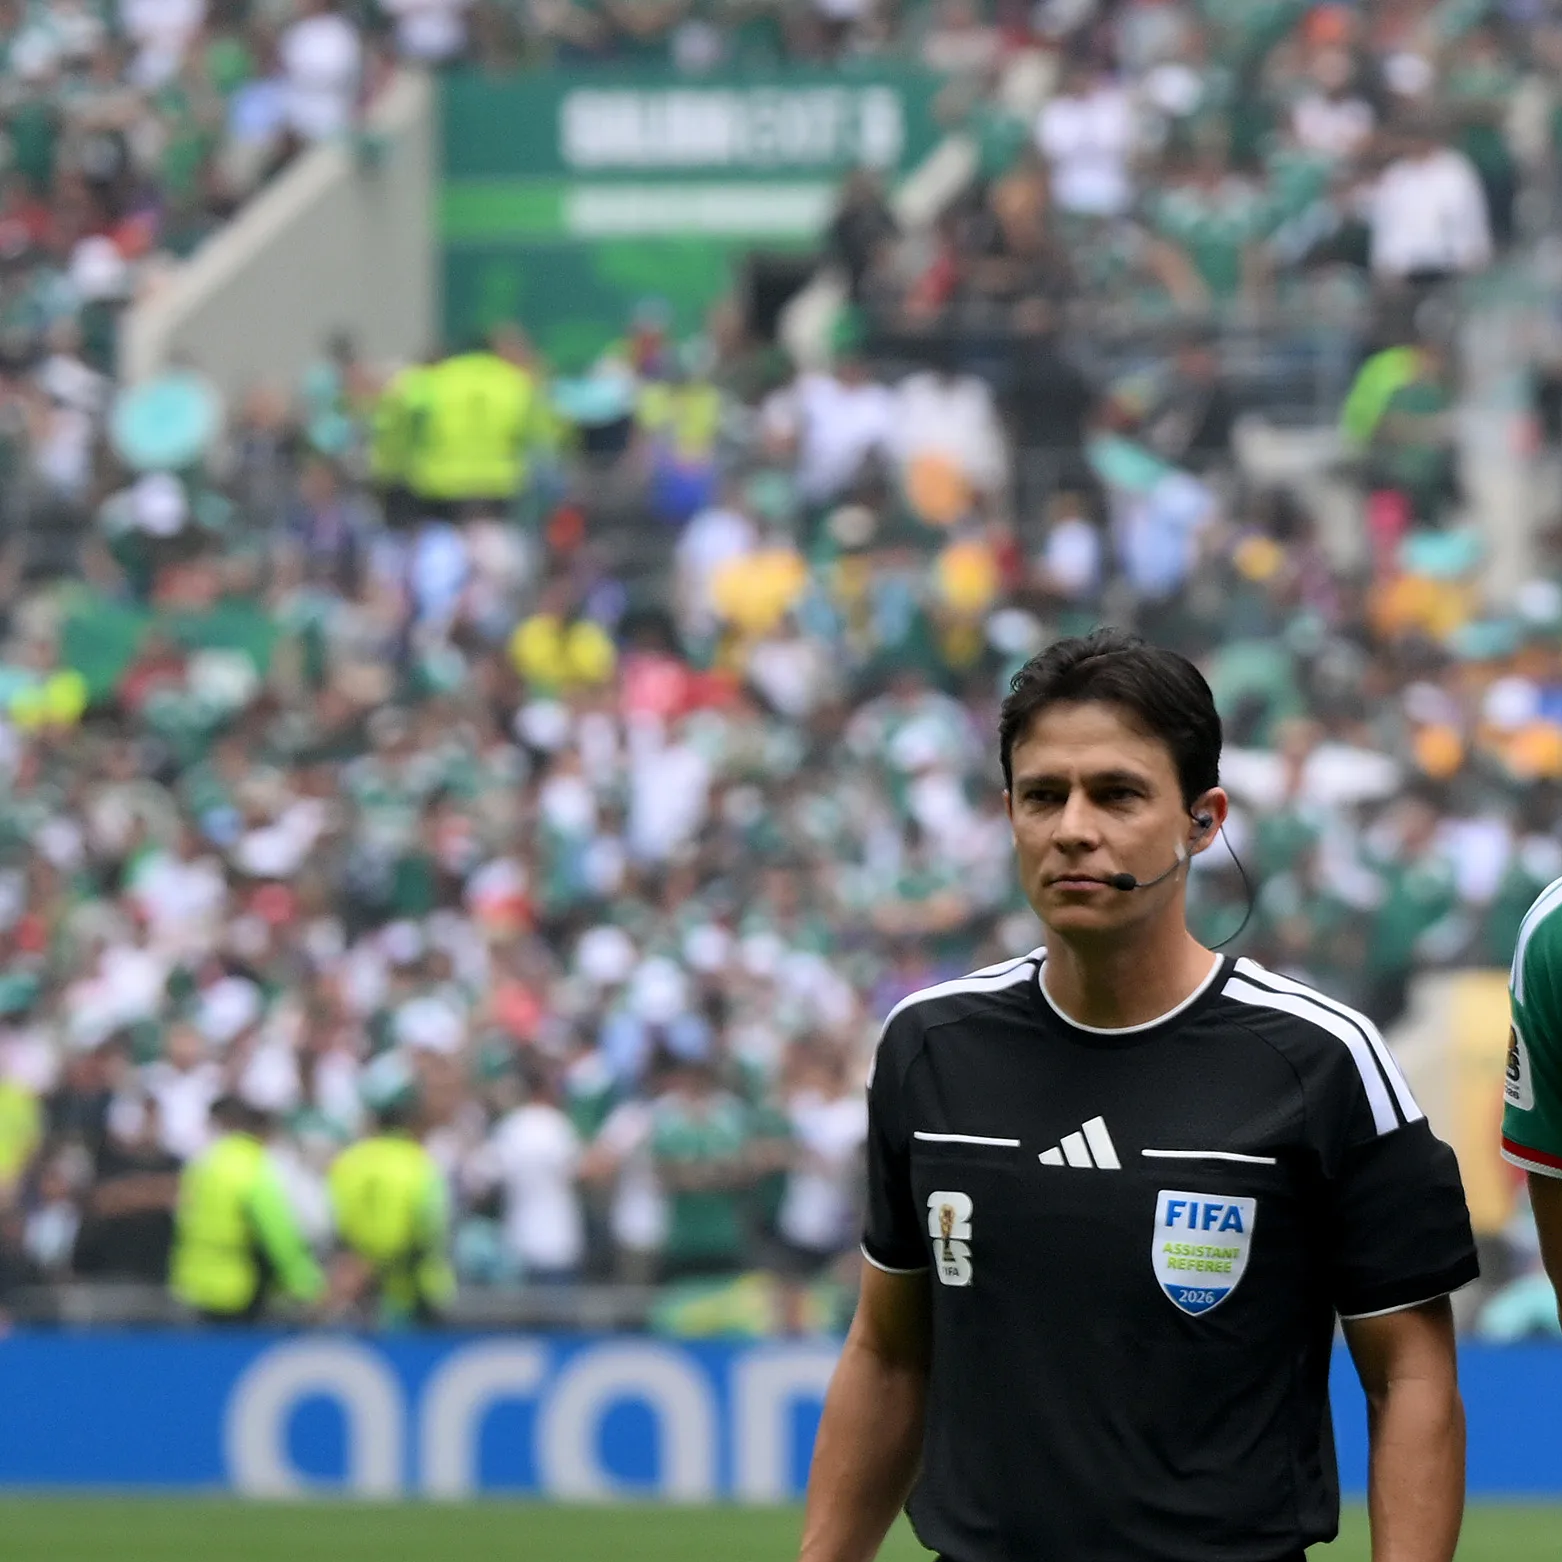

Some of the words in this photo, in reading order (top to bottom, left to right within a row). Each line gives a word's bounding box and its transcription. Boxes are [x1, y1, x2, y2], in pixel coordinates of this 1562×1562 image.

[1165, 1199, 1244, 1234] FIFA
[1162, 1242, 1241, 1260] ASSISTANT
[942, 1266, 960, 1277] IFA
[1167, 1255, 1234, 1274] REFEREE
[1178, 1289, 1216, 1305] 2026
